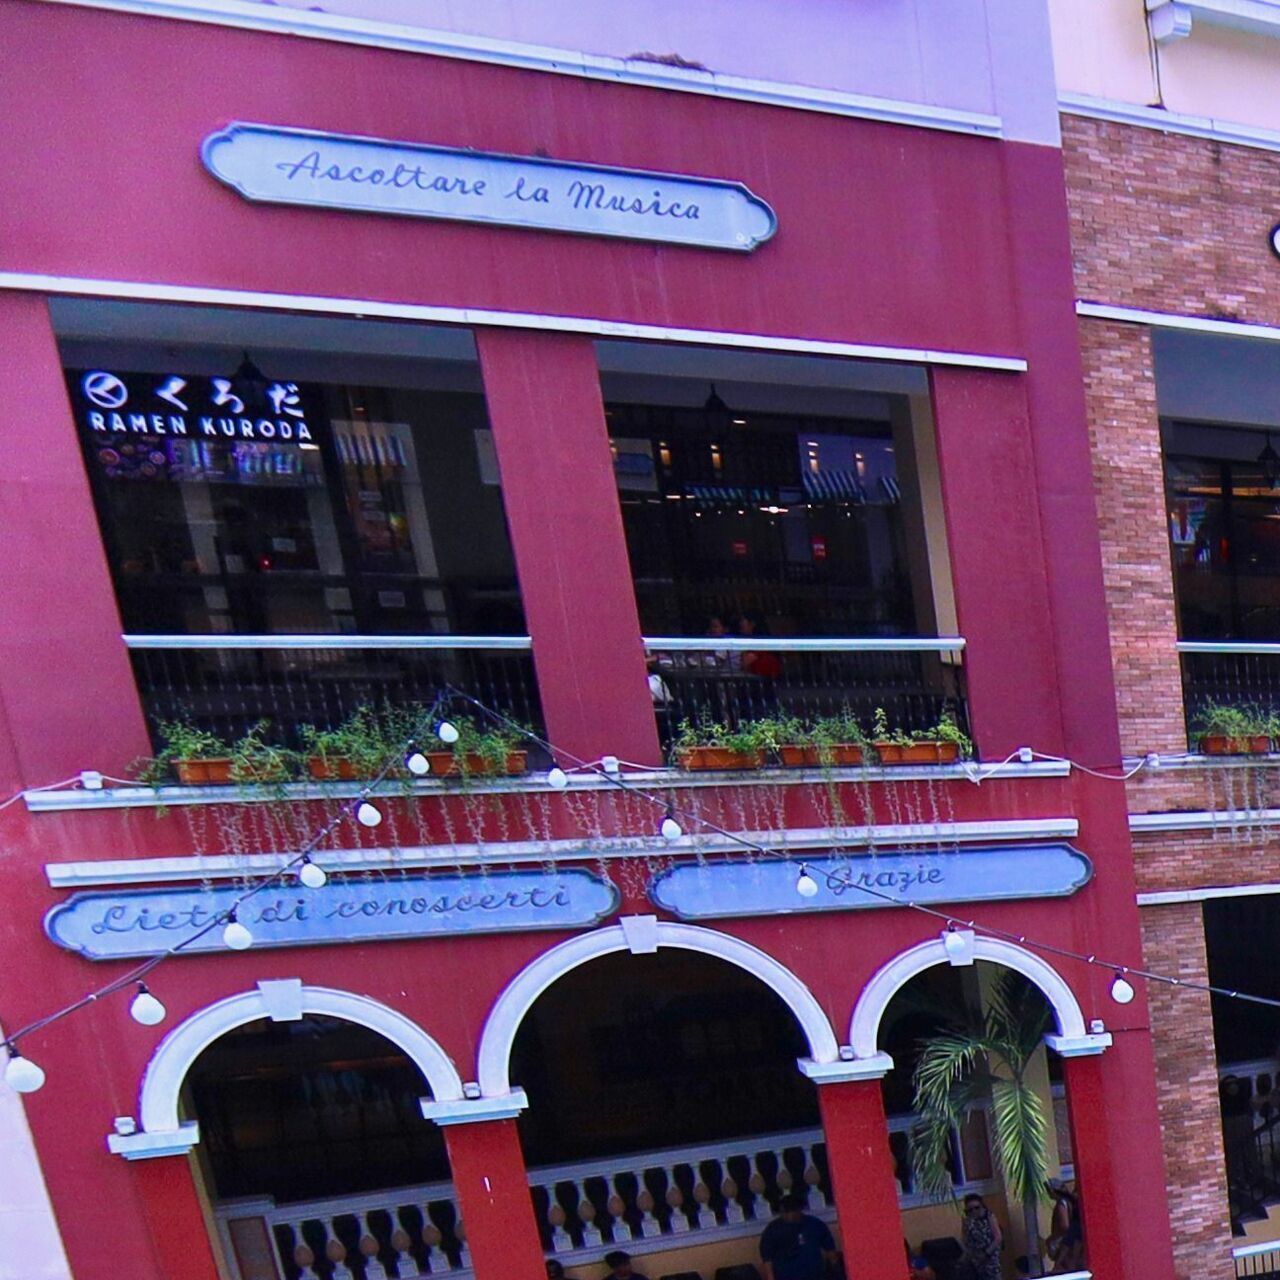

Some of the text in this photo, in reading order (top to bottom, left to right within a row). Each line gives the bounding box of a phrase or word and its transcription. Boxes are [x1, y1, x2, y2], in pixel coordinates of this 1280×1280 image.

[276, 151, 701, 220] Ascoltare la Musica
[155, 374, 305, 419] くろだ
[91, 412, 313, 440] RAMEN KURODA
[826, 864, 945, 896] Grazie
[253, 898, 309, 923] di
[325, 884, 569, 920] conoscerti
